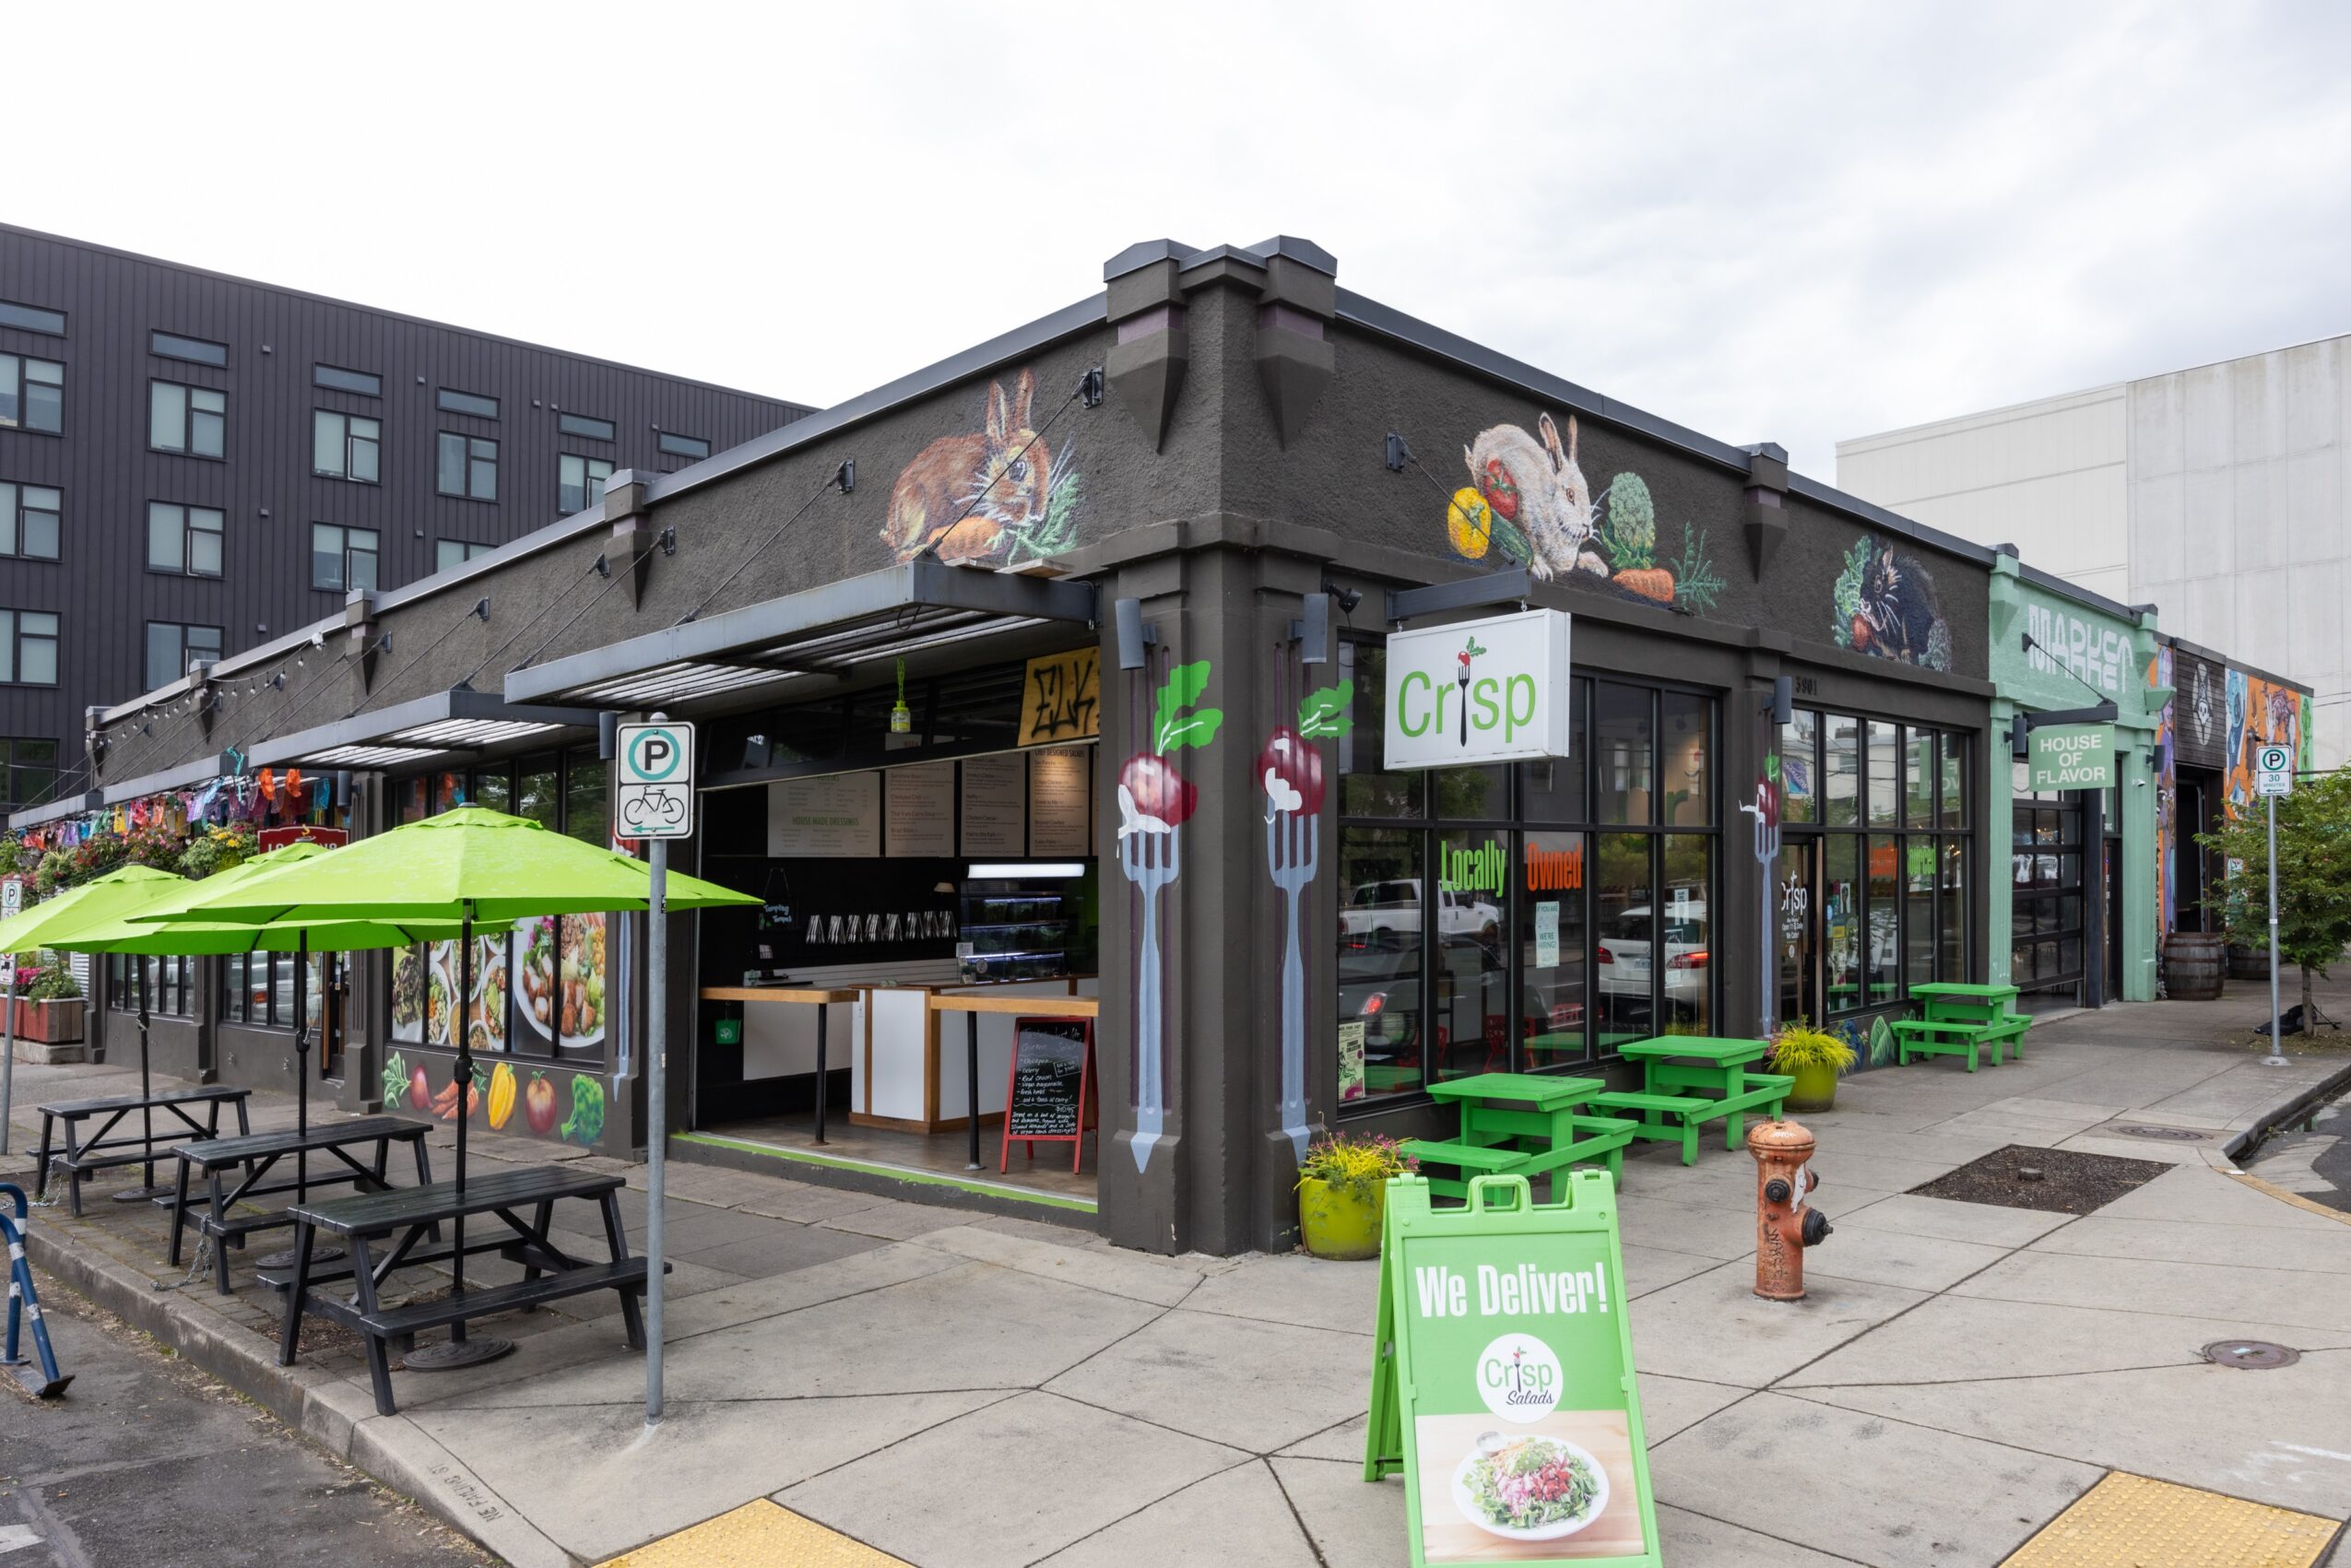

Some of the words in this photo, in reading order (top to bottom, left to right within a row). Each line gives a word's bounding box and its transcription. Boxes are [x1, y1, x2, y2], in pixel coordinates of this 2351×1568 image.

[1399, 658, 1536, 748] Crisp
[2040, 735, 2102, 752] HOUSE
[644, 740, 669, 771] P
[2059, 752, 2083, 767] OF
[2269, 753, 2280, 766] P
[2037, 767, 2106, 784] FLAVOR
[1441, 840, 1506, 898] Locally
[1527, 841, 1582, 891] Owned
[8, 889, 16, 902] P
[1415, 1267, 1468, 1317] We
[1477, 1262, 1608, 1315] Deliver!
[1484, 1355, 1554, 1393] Crisp
[1506, 1390, 1554, 1405] Salads
